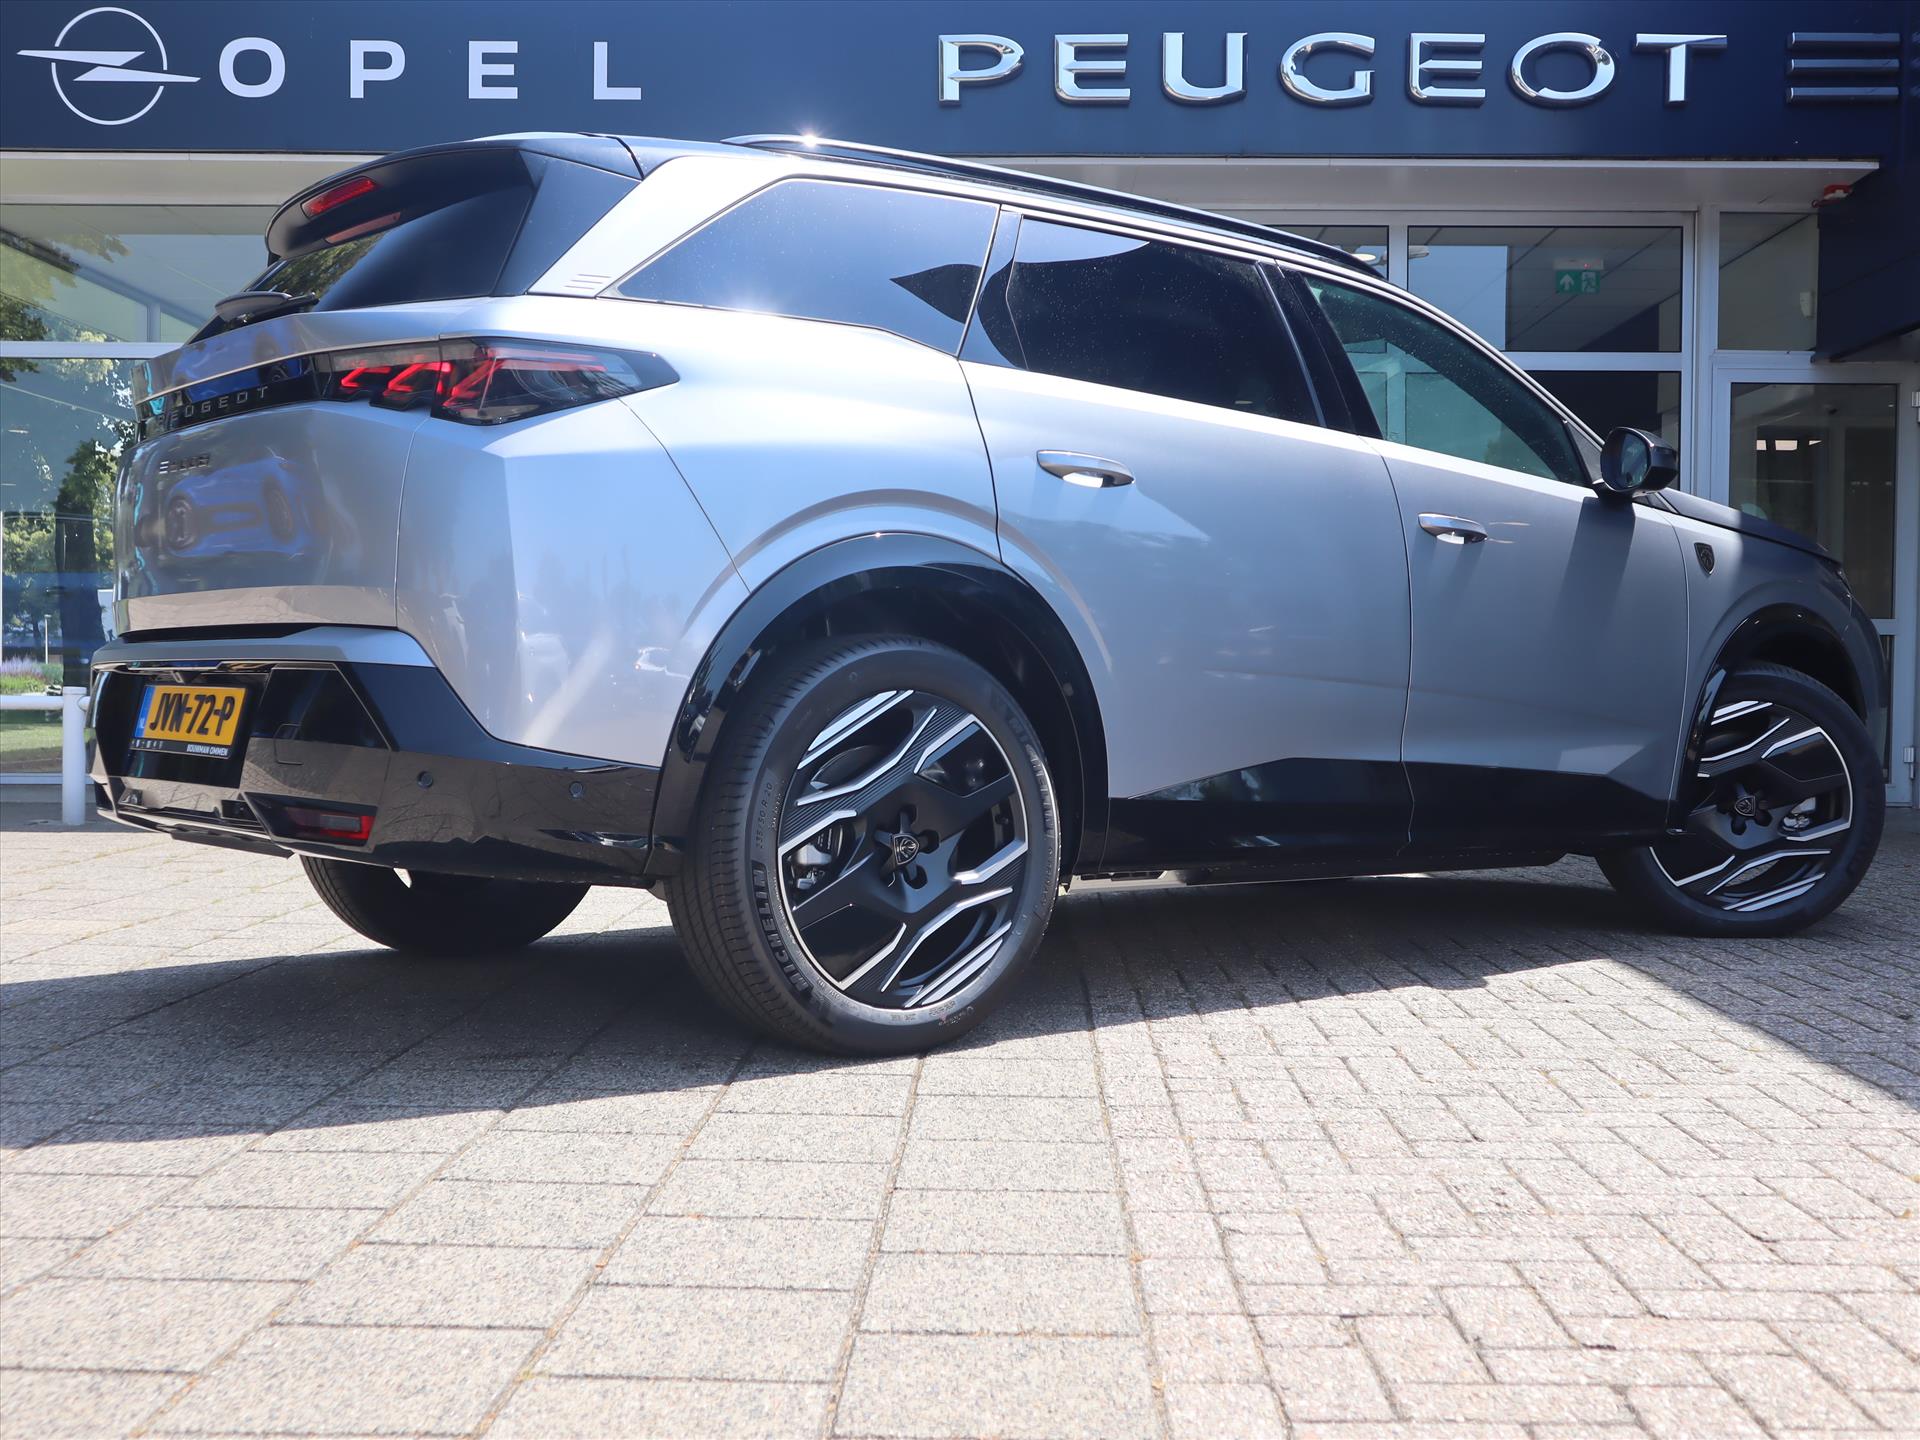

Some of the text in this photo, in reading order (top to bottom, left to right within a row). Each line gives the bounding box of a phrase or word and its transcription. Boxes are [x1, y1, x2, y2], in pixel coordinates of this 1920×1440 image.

[218, 37, 642, 100] OPEL
[937, 31, 1728, 107] PEUGEOT
[149, 692, 235, 736] JVN-72-P
[752, 868, 810, 992] MICHELIN
